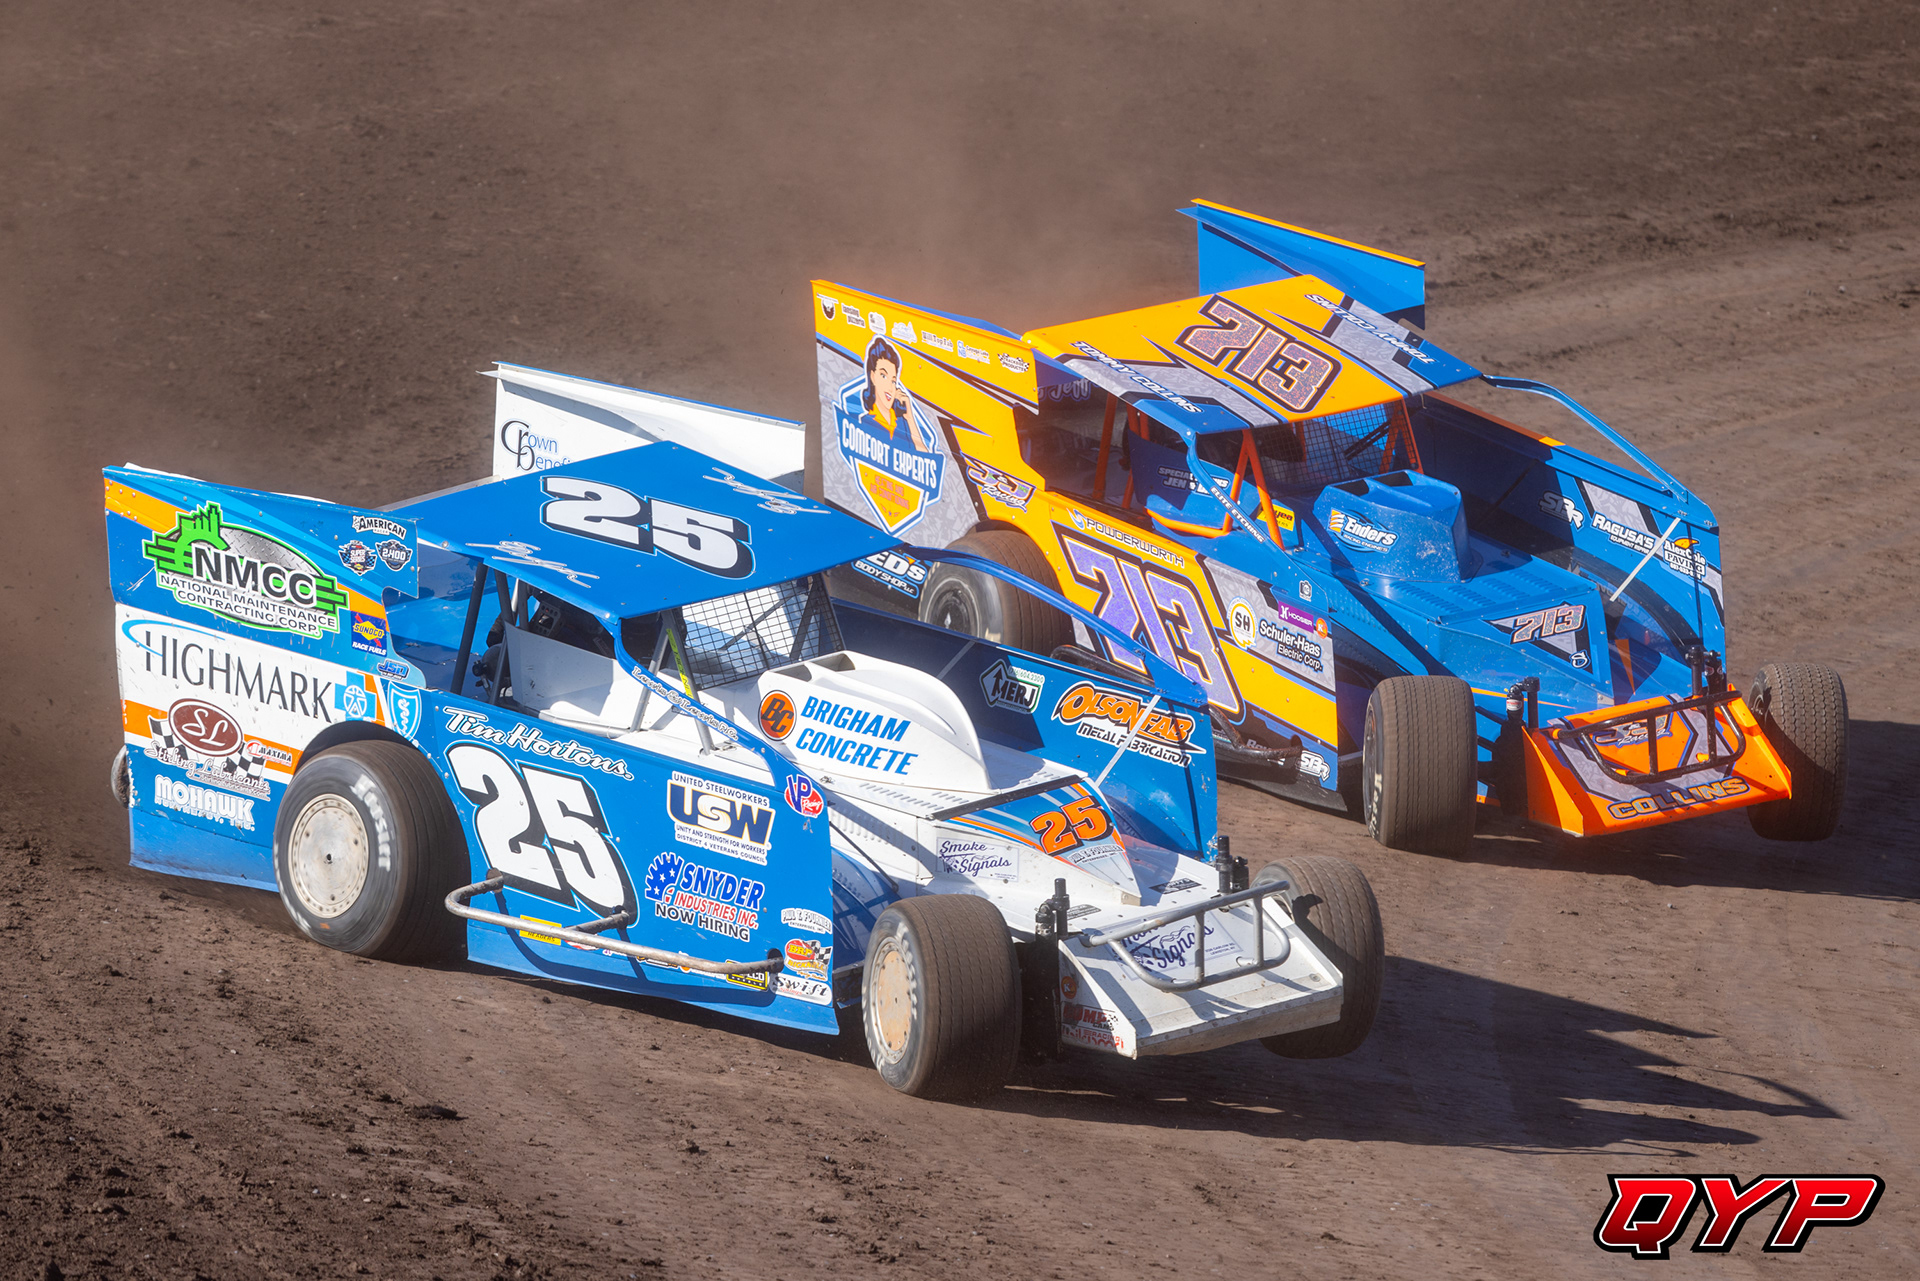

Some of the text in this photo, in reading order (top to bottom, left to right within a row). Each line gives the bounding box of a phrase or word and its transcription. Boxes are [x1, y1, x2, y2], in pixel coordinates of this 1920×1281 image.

[1306, 294, 1377, 330] COLLINS
[1073, 340, 1203, 413] TOMMY COLLINS
[501, 420, 558, 455] Crown
[842, 418, 937, 489] COMFORT EXPERTS
[982, 484, 1027, 513] Racing
[1163, 477, 1187, 489] JEN
[359, 518, 405, 538] AMERICAN
[542, 476, 753, 579] 25
[1210, 486, 1234, 511] ELITE
[1231, 508, 1266, 544] ETCHING
[1344, 516, 1397, 546] Enders
[1592, 513, 1656, 549] RAGUSA'S
[1087, 518, 1184, 568] POWDERWORTH
[1343, 534, 1388, 552] RACING ENGINES
[194, 547, 315, 607] NMCC
[855, 560, 879, 577] BODY
[880, 572, 907, 590] SHOP
[1667, 553, 1703, 573] PAVING
[161, 575, 335, 628] NATIONAL MAINTENANCE
[178, 590, 319, 636] CONTRACTING CORP.
[1288, 611, 1313, 627] HOOSIER
[354, 623, 385, 640] SUNOCO
[1235, 612, 1251, 632] SH
[1259, 620, 1321, 658] Schuler-Haas
[1512, 603, 1587, 644] 713
[352, 641, 386, 656] RACE FUELS
[1278, 644, 1323, 672] Electric Corp.
[145, 630, 333, 724] HIGHMARK
[991, 672, 1036, 707] MERJ
[443, 706, 506, 744] Tim
[761, 697, 794, 733] BC
[800, 695, 912, 743] BRIGHAM
[144, 740, 271, 791] Stirling Lubricants
[258, 746, 292, 762] MAXIMA
[796, 727, 918, 776] CONCRETE
[155, 774, 255, 823] MOHAWK
[673, 772, 768, 807] UNITED STEELWORKERS
[786, 774, 812, 813] VP
[802, 798, 823, 813] Racing
[1609, 777, 1750, 820] COLLINS
[447, 741, 634, 916] 25
[669, 781, 774, 846] USW
[1029, 796, 1112, 857] 25
[676, 833, 703, 847] DISTRICT
[709, 843, 739, 857] VETERANS
[740, 851, 766, 864] COUNCIL
[677, 824, 766, 856] UNITY AND STRENGTH FOR WORKERS
[939, 840, 988, 855] Smoke
[958, 856, 1013, 878] Signals
[681, 864, 765, 910] SNYDER
[656, 904, 751, 942] NOW HIRING
[674, 891, 760, 930] INDUSTRIES INC.
[788, 944, 813, 958] BRP
[1152, 923, 1215, 969] Signas
[787, 959, 826, 972] BICKNELL
[773, 976, 829, 998] Swift
